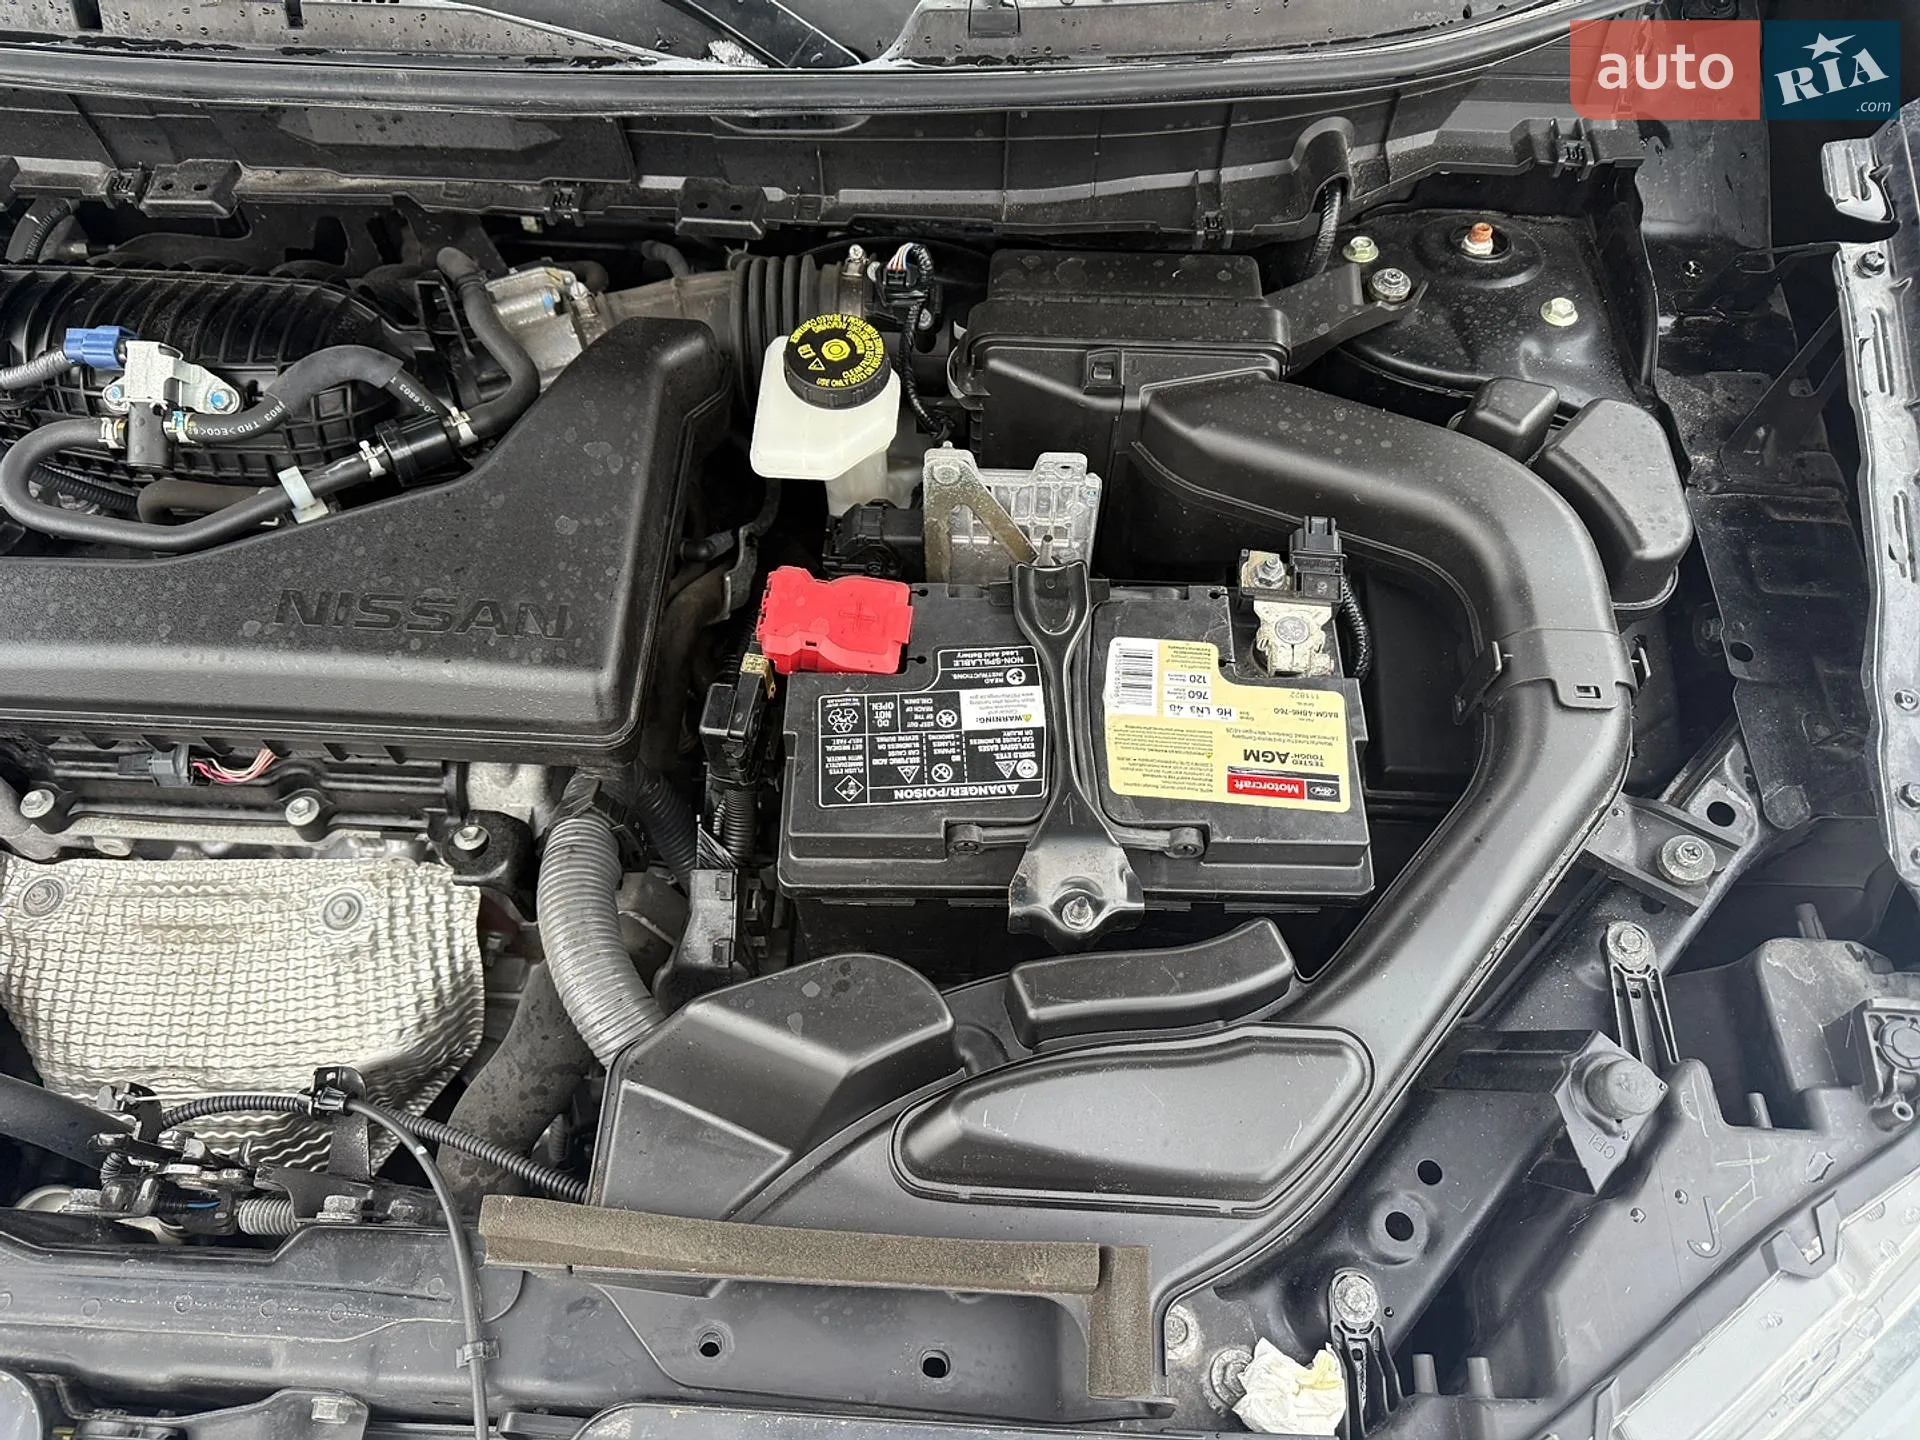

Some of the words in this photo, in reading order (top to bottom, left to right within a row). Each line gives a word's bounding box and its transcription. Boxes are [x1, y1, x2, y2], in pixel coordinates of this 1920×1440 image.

[273, 588, 569, 640] NISSAN
[956, 651, 982, 659] Battery
[953, 656, 1024, 666] NON-SPILLABLE
[1189, 674, 1207, 684] 120
[1188, 690, 1209, 700] 760
[869, 701, 894, 710] OPEN.
[1189, 705, 1211, 715] LN3
[874, 710, 892, 719] NOT
[1216, 707, 1232, 717] H6
[877, 719, 889, 727] DO
[976, 714, 1023, 724] WARNING:
[1243, 749, 1290, 764] AGM
[1292, 759, 1324, 767] TESTED
[894, 784, 1007, 800] DANGER/POISON
[1234, 780, 1299, 794] Motorcraft
